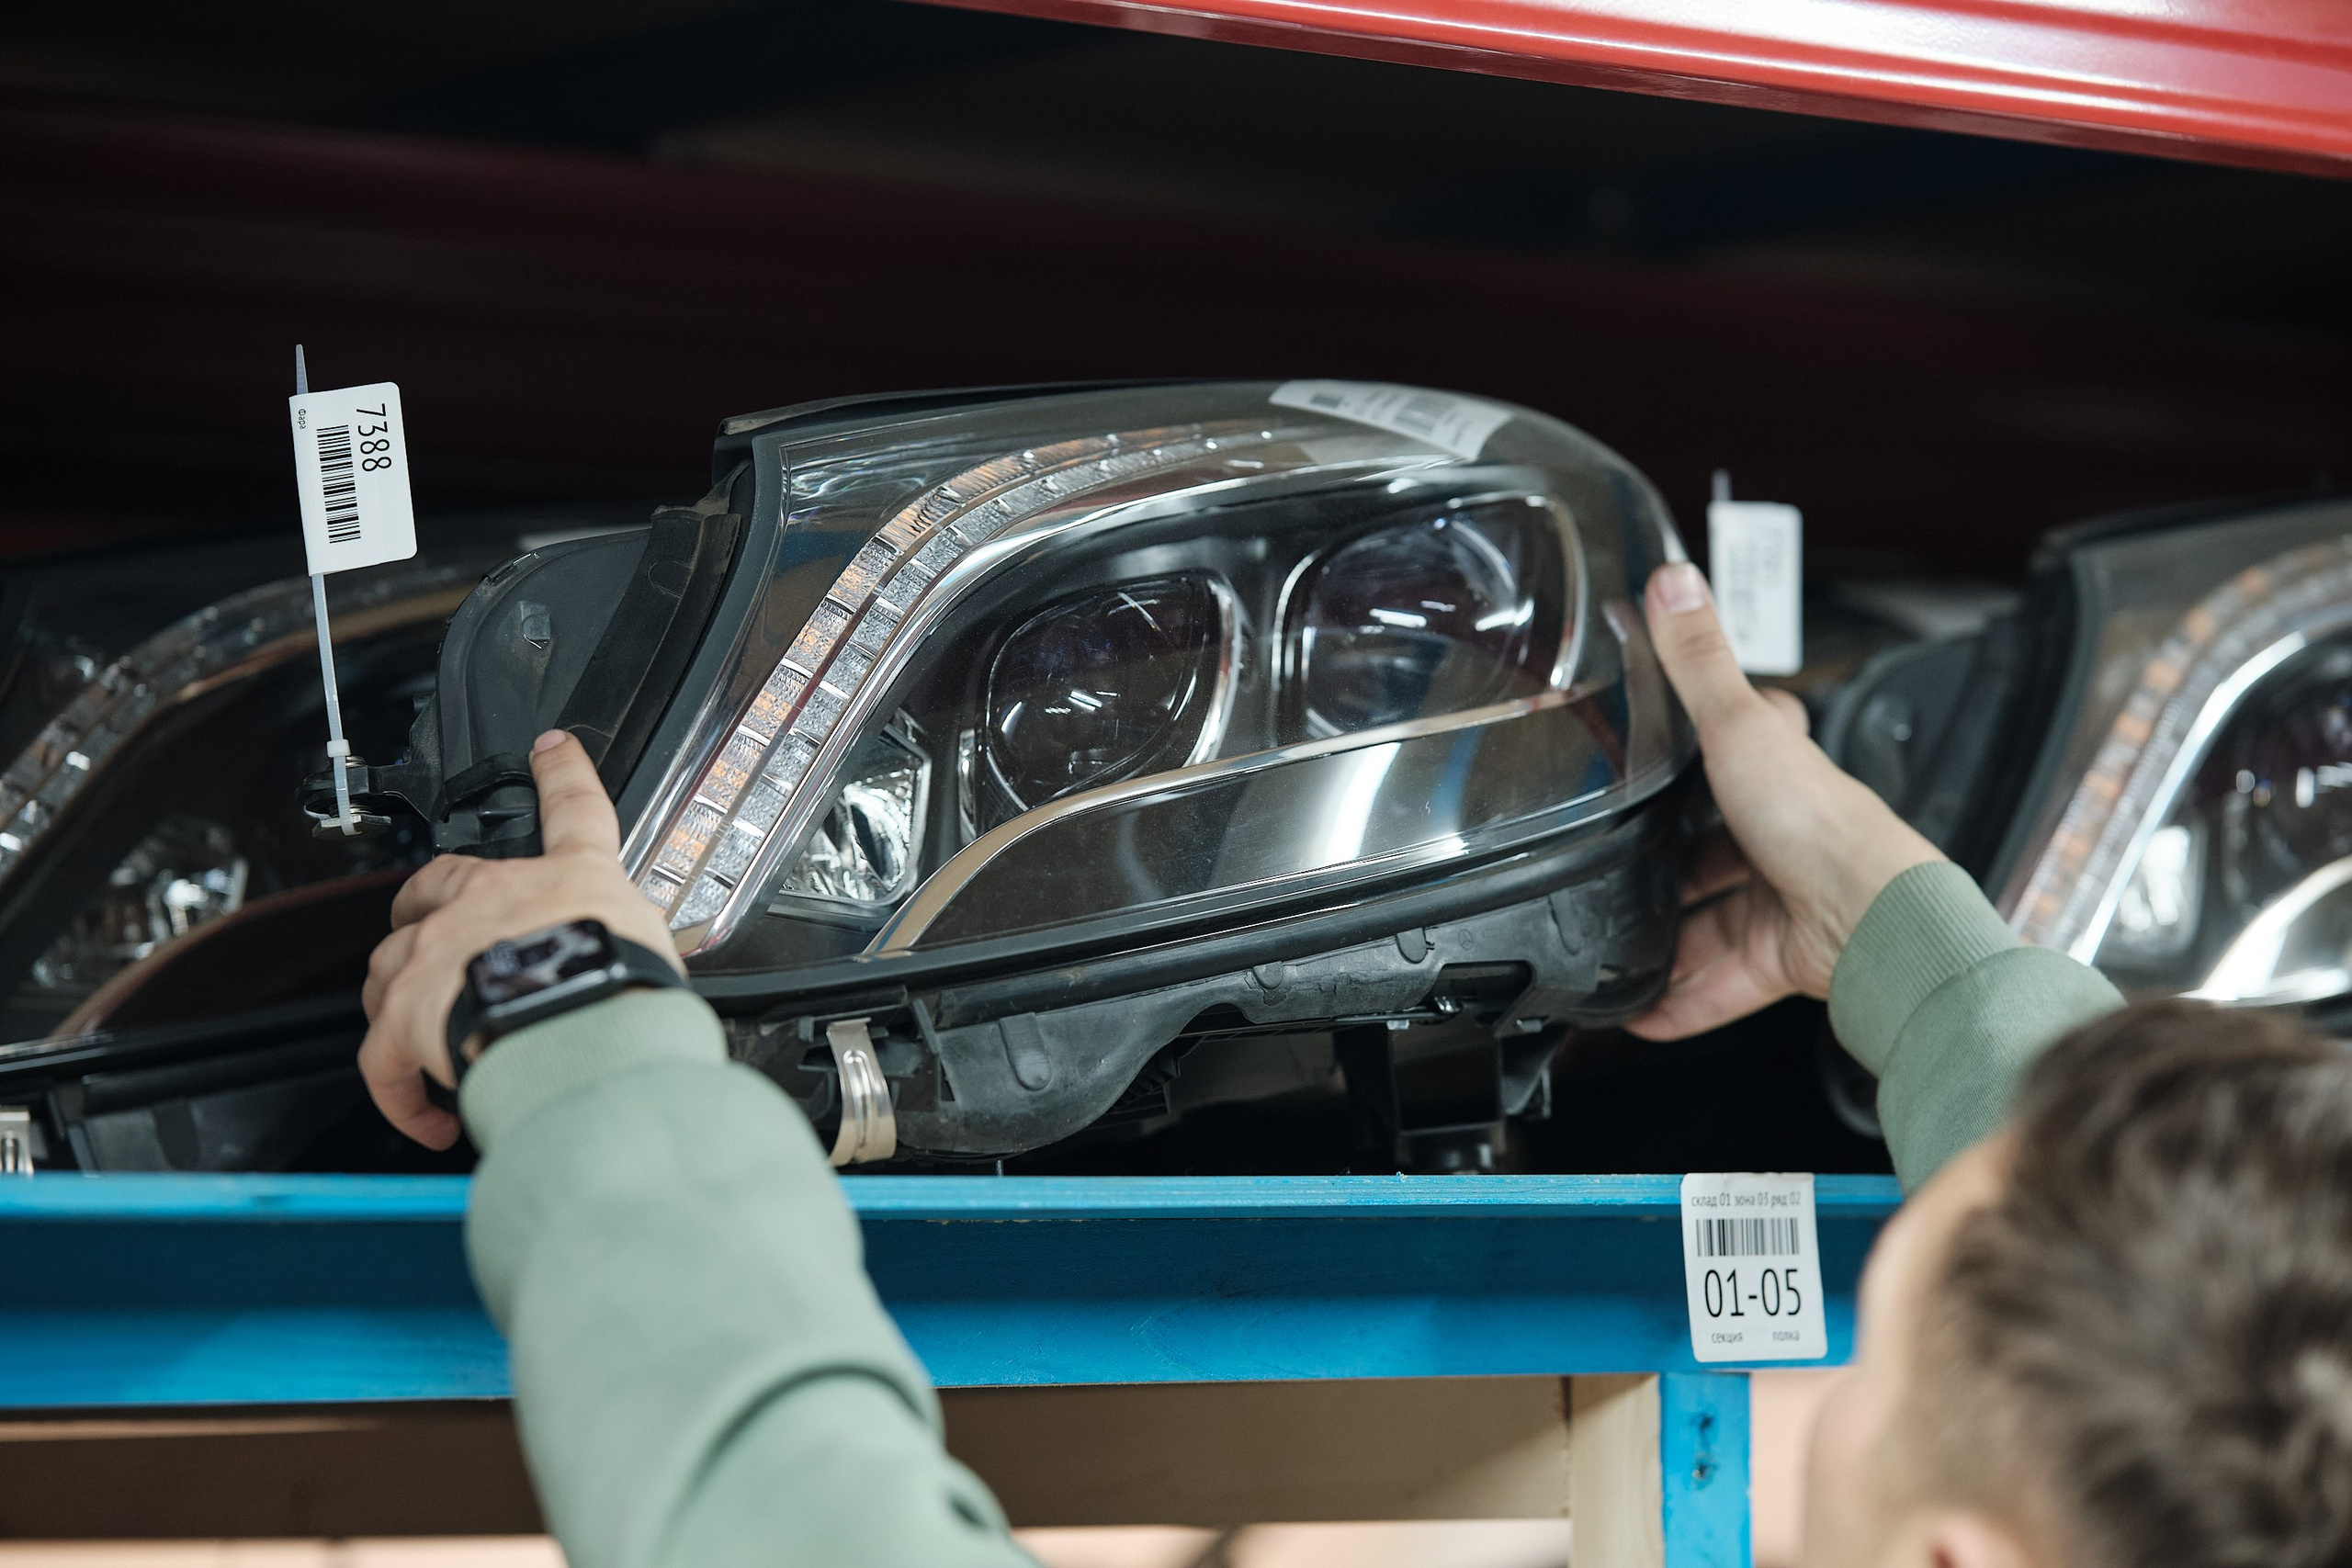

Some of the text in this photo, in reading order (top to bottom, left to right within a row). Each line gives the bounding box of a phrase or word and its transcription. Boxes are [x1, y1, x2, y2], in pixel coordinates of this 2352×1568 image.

[297, 409, 306, 429] Фара
[356, 403, 391, 471] 7388
[1691, 1196, 1717, 1208] склад
[1719, 1192, 1731, 1206] 01
[1734, 1195, 1755, 1206] зона
[1770, 1195, 1788, 1208] ряд
[1704, 1269, 1801, 1317] 01-05
